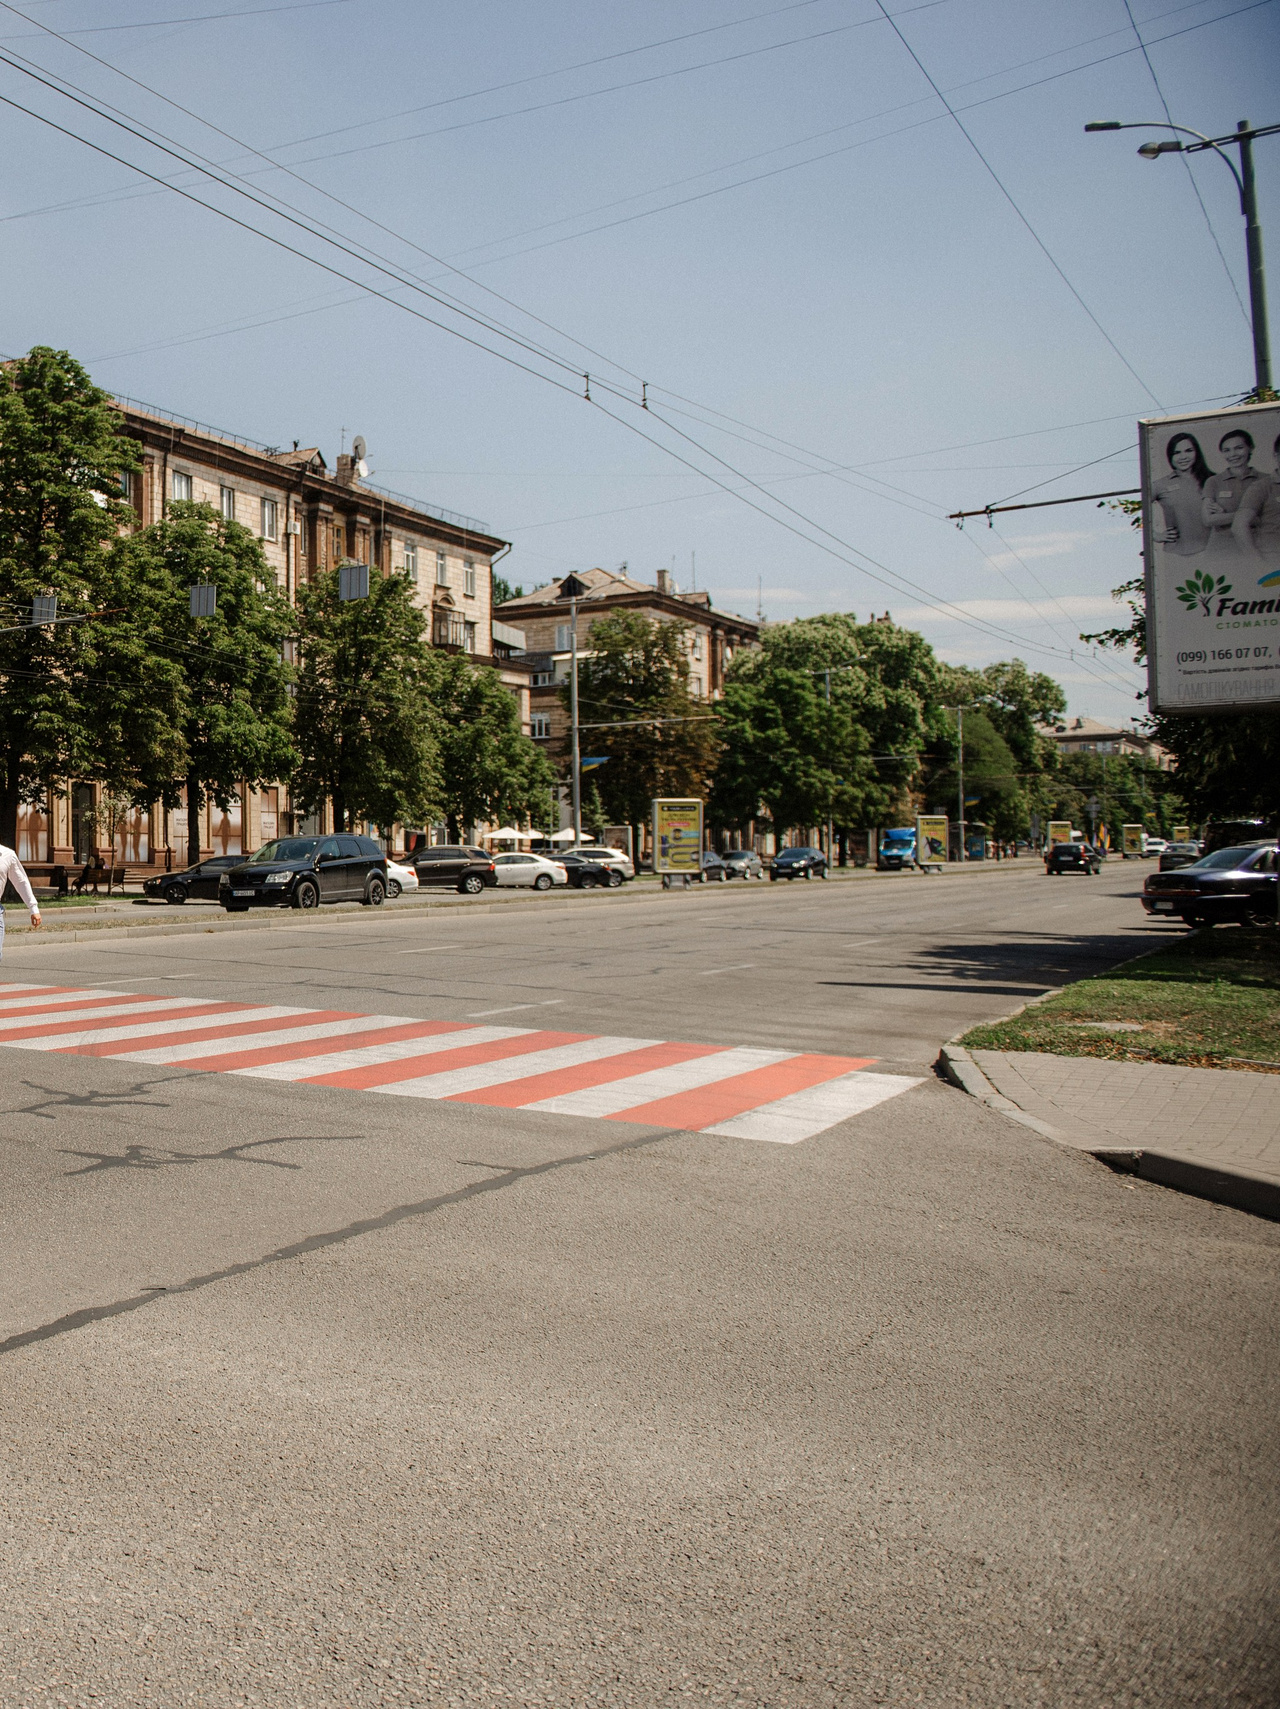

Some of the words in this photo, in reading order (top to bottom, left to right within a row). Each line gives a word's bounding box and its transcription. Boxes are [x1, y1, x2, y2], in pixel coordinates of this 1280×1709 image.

[1216, 619, 1278, 630] СТОМАТО
[1177, 651, 1207, 664] (099)
[1211, 649, 1233, 660] 166
[1235, 647, 1251, 659] 07
[1254, 646, 1273, 659] 07,
